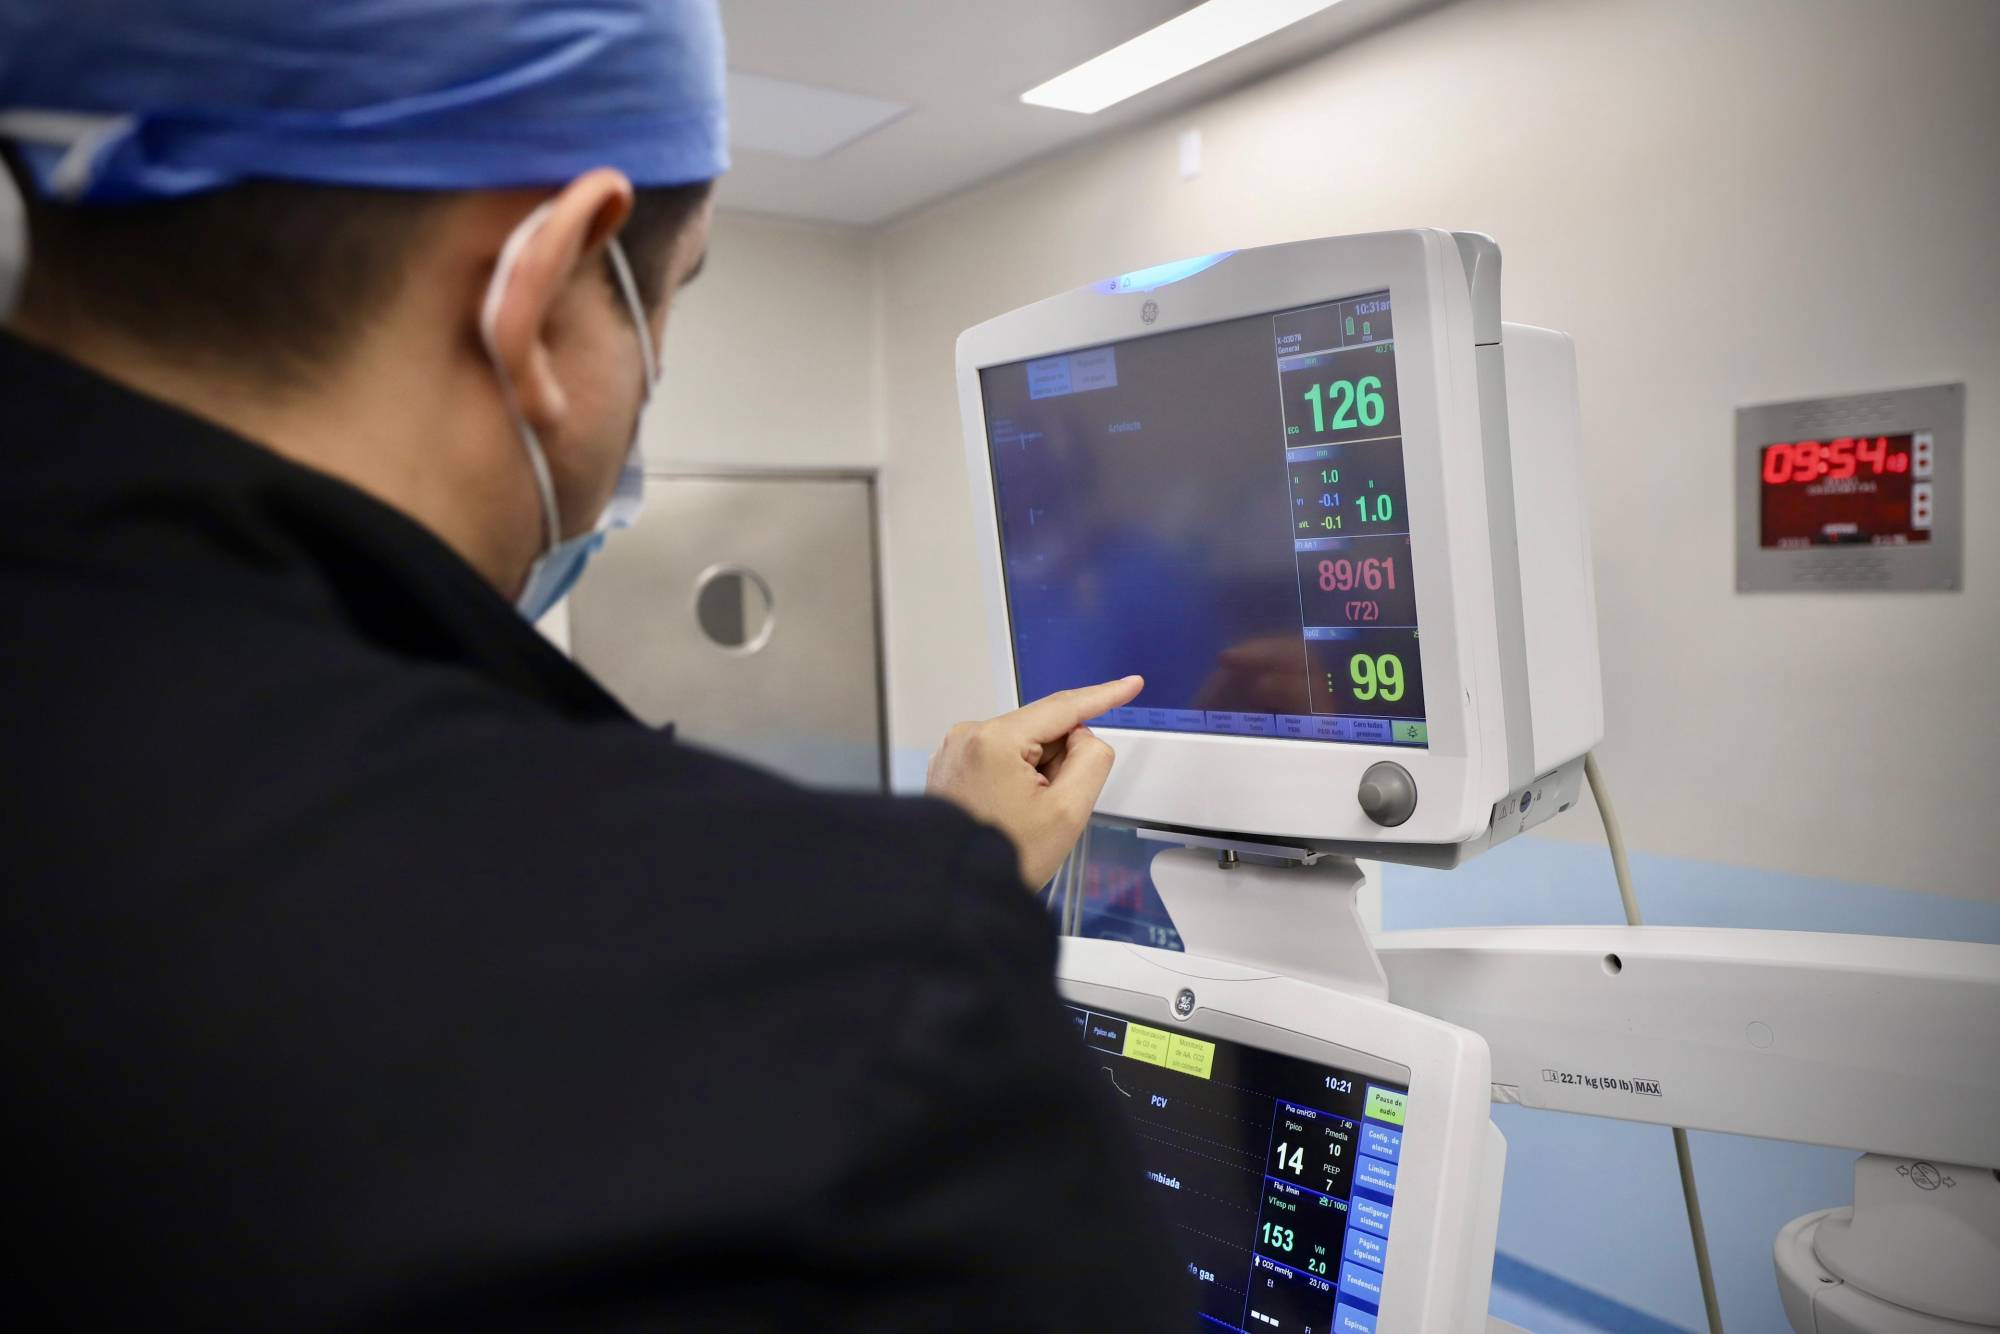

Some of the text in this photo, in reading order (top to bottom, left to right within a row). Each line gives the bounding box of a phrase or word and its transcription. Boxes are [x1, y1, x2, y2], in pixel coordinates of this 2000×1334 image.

[1278, 344, 1300, 354] General
[1304, 376, 1385, 432] 126
[1288, 426, 1300, 434] ECG
[1763, 436, 1888, 484] 09:54
[1321, 469, 1339, 483] 1.0
[1319, 493, 1340, 507] -0.1
[1356, 494, 1393, 522] 1.0
[1320, 515, 1341, 529] -0.1
[1318, 556, 1396, 591] 89/61
[1345, 601, 1379, 620] (72)
[1350, 653, 1405, 701] 99
[1325, 1076, 1352, 1094] 10:21
[1560, 1072, 1661, 1094] 22.7 kg (50 lb) MAX
[1151, 1095, 1168, 1108] PCV
[1376, 1094, 1394, 1105] Pausa
[1380, 1108, 1396, 1117] audio
[1285, 1121, 1303, 1132] Ppico
[1325, 1127, 1348, 1141] Pmedia
[1368, 1130, 1400, 1145] Config. de
[1329, 1143, 1341, 1157] 10
[1372, 1143, 1393, 1155] alarma
[1277, 1142, 1304, 1175] 14
[1323, 1163, 1341, 1174] PEEP
[1146, 1171, 1180, 1189] mbiada
[1326, 1179, 1333, 1191] 7
[1333, 1201, 1348, 1212] 1000
[1358, 1203, 1390, 1219] Configurar
[1360, 1217, 1383, 1230] sistema
[1262, 1222, 1294, 1252] 153
[1314, 1244, 1325, 1256] VM
[1353, 1249, 1381, 1264] siguiente
[1262, 1259, 1293, 1279] CO2 mmHg
[1308, 1258, 1326, 1274] 2.0
[1199, 1269, 1215, 1281] gas
[1346, 1274, 1380, 1293] Tendencias
